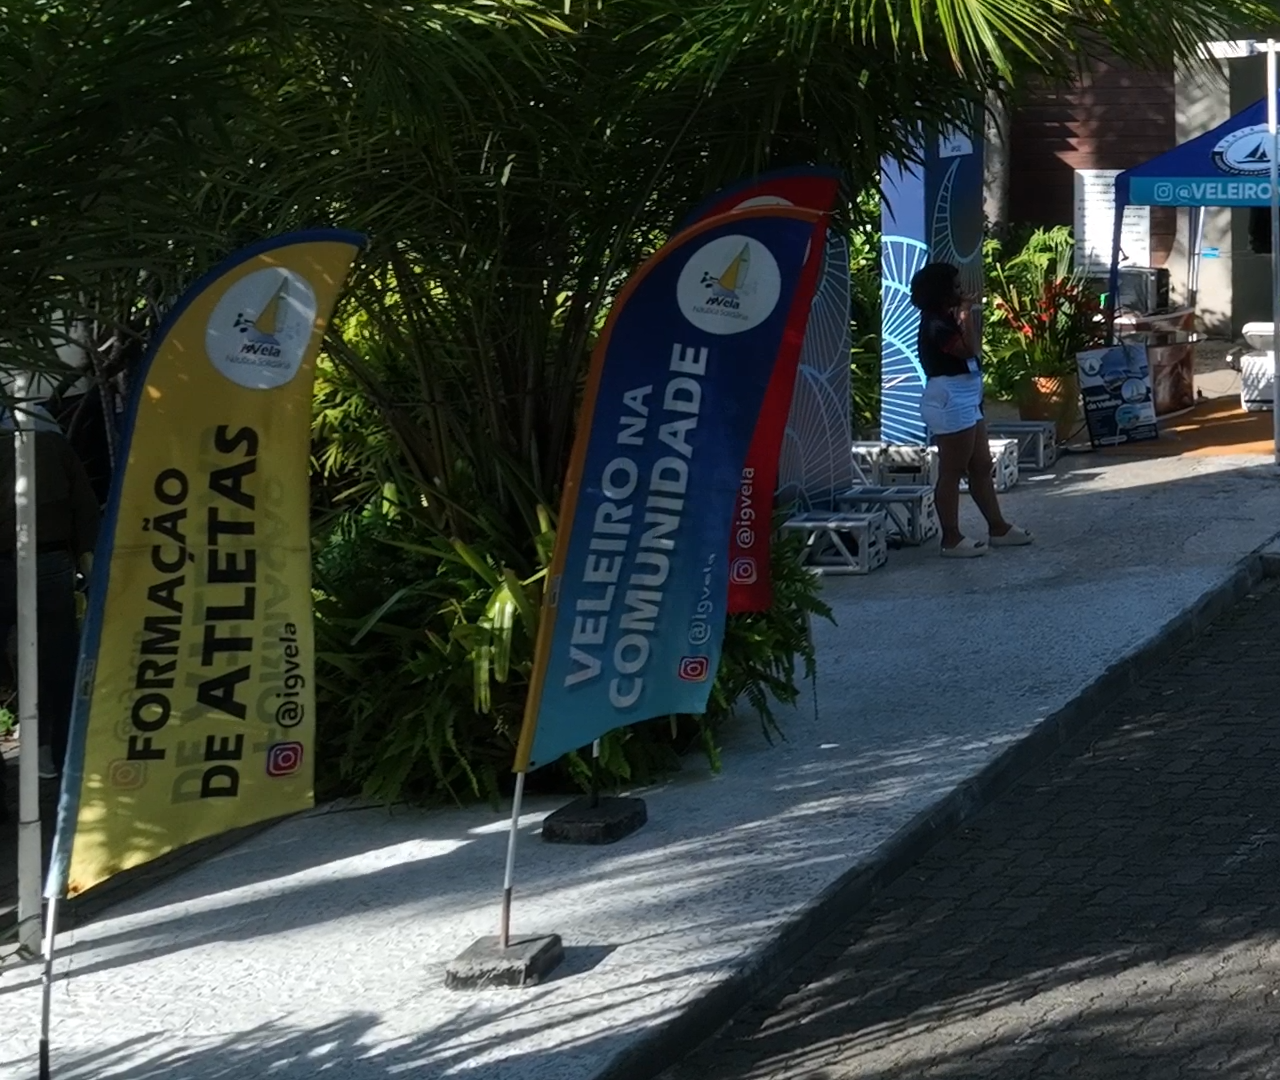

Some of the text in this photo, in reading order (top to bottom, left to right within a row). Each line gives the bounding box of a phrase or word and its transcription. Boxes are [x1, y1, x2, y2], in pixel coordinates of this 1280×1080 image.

[127, 468, 195, 760] FORMAÇÃO
[196, 424, 259, 799] DE ATLETAS
[563, 384, 653, 688] VELEIRO NA
[608, 343, 709, 709] COMUNIDADE
[736, 467, 755, 549] @igvela
[275, 622, 306, 728] @igvela
